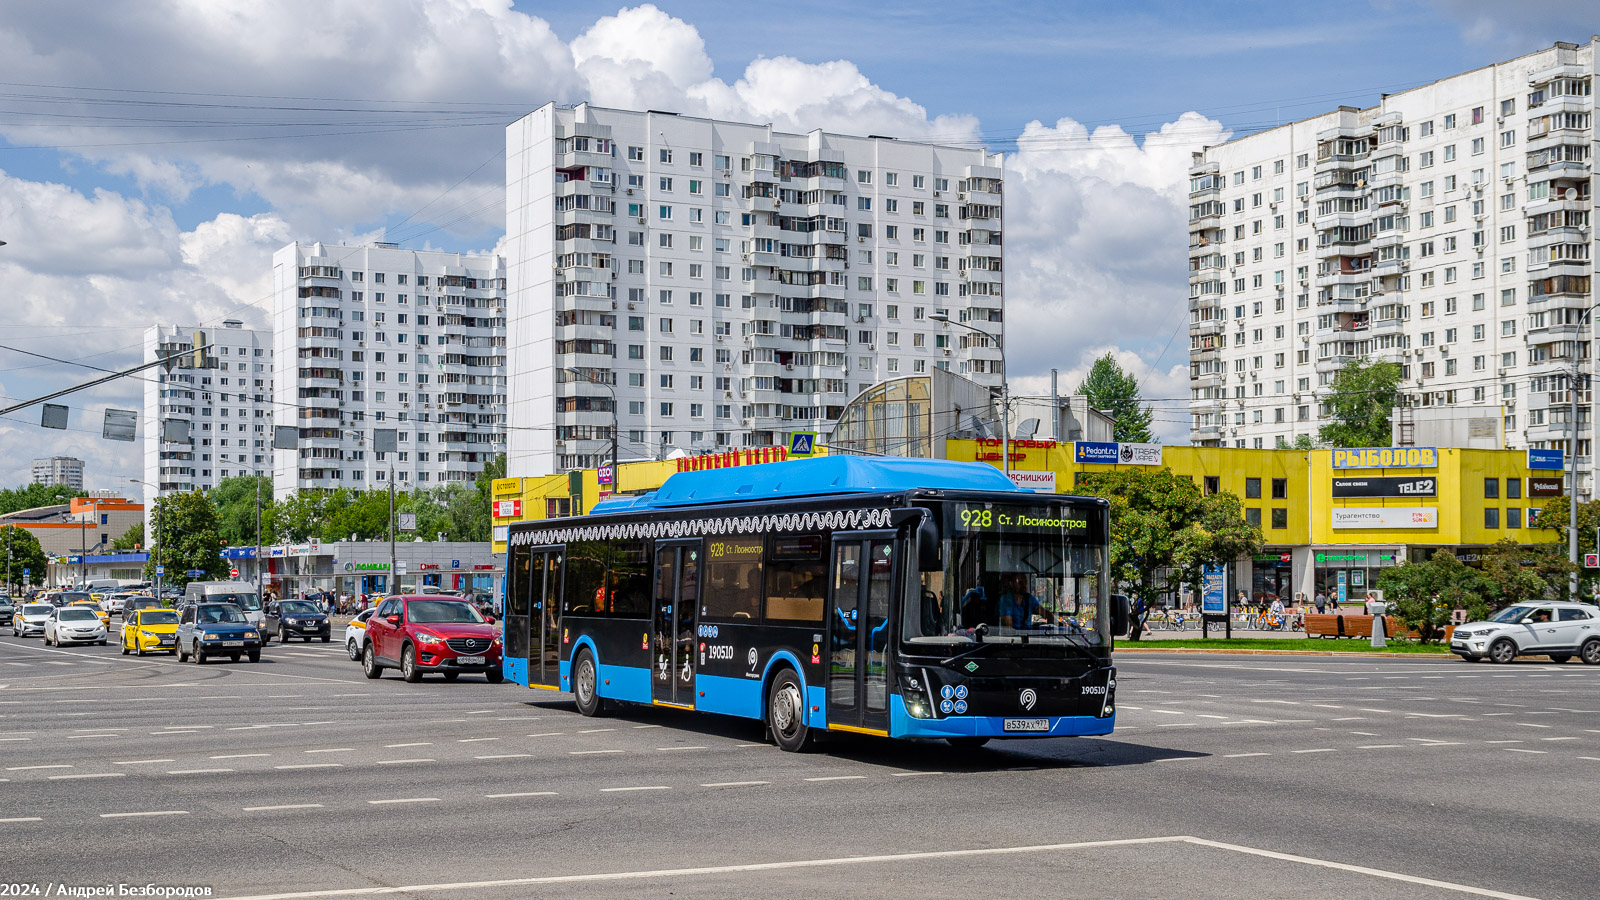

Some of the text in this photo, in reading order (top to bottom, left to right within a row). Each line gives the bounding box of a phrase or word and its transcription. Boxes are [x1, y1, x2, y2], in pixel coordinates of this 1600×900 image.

[1086, 447, 1117, 455] Pedant.ru
[1334, 449, 1434, 467] РЫБОЛОВ
[1008, 472, 1054, 482] ЯСНИЦКИЙ
[1398, 480, 1434, 493] TELE2
[960, 509, 993, 528] 928
[998, 513, 1013, 526] Ст.
[1335, 512, 1381, 520] Турагентство
[710, 542, 725, 557] 928
[708, 645, 734, 660] 190510
[1082, 685, 1106, 696] 190510
